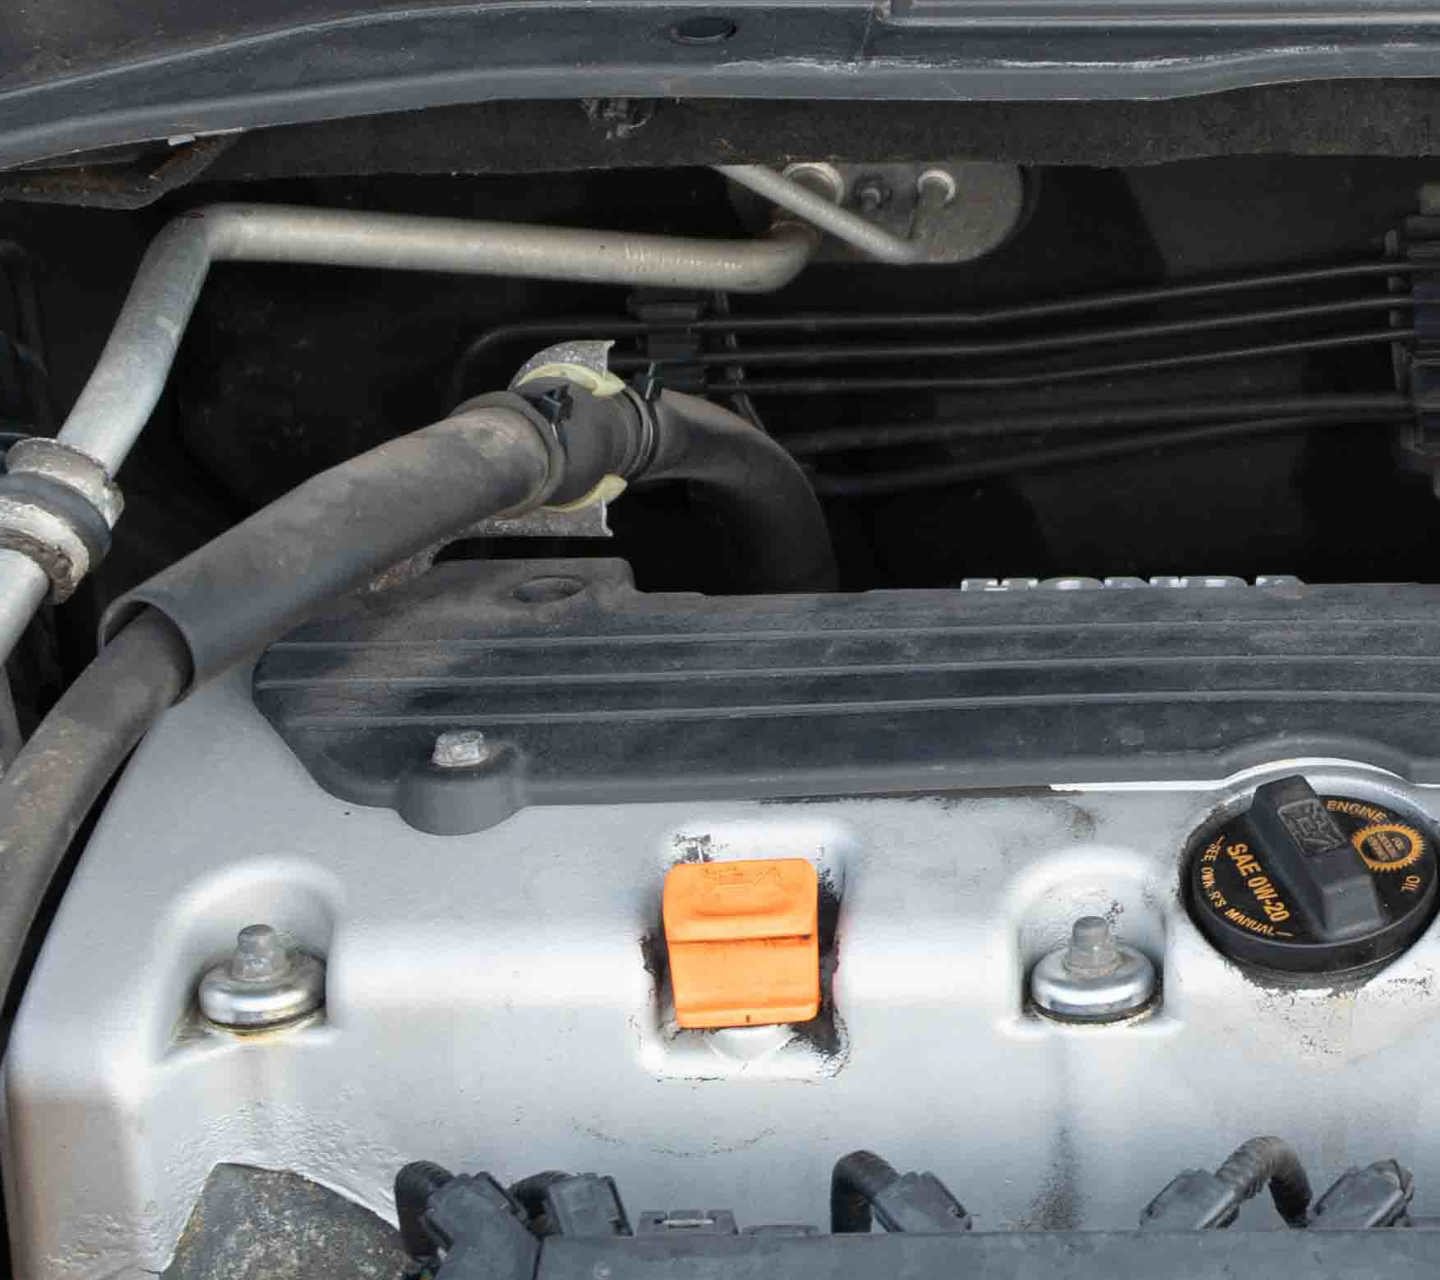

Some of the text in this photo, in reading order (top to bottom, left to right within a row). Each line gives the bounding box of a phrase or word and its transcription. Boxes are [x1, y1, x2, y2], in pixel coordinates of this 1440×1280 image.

[1326, 799, 1388, 823] ENGINE
[1201, 866, 1228, 909] OWNR'S
[1224, 907, 1278, 938] MANUAL
[1227, 842, 1292, 924] SAE 0W-20
[1400, 874, 1422, 894] OIL
